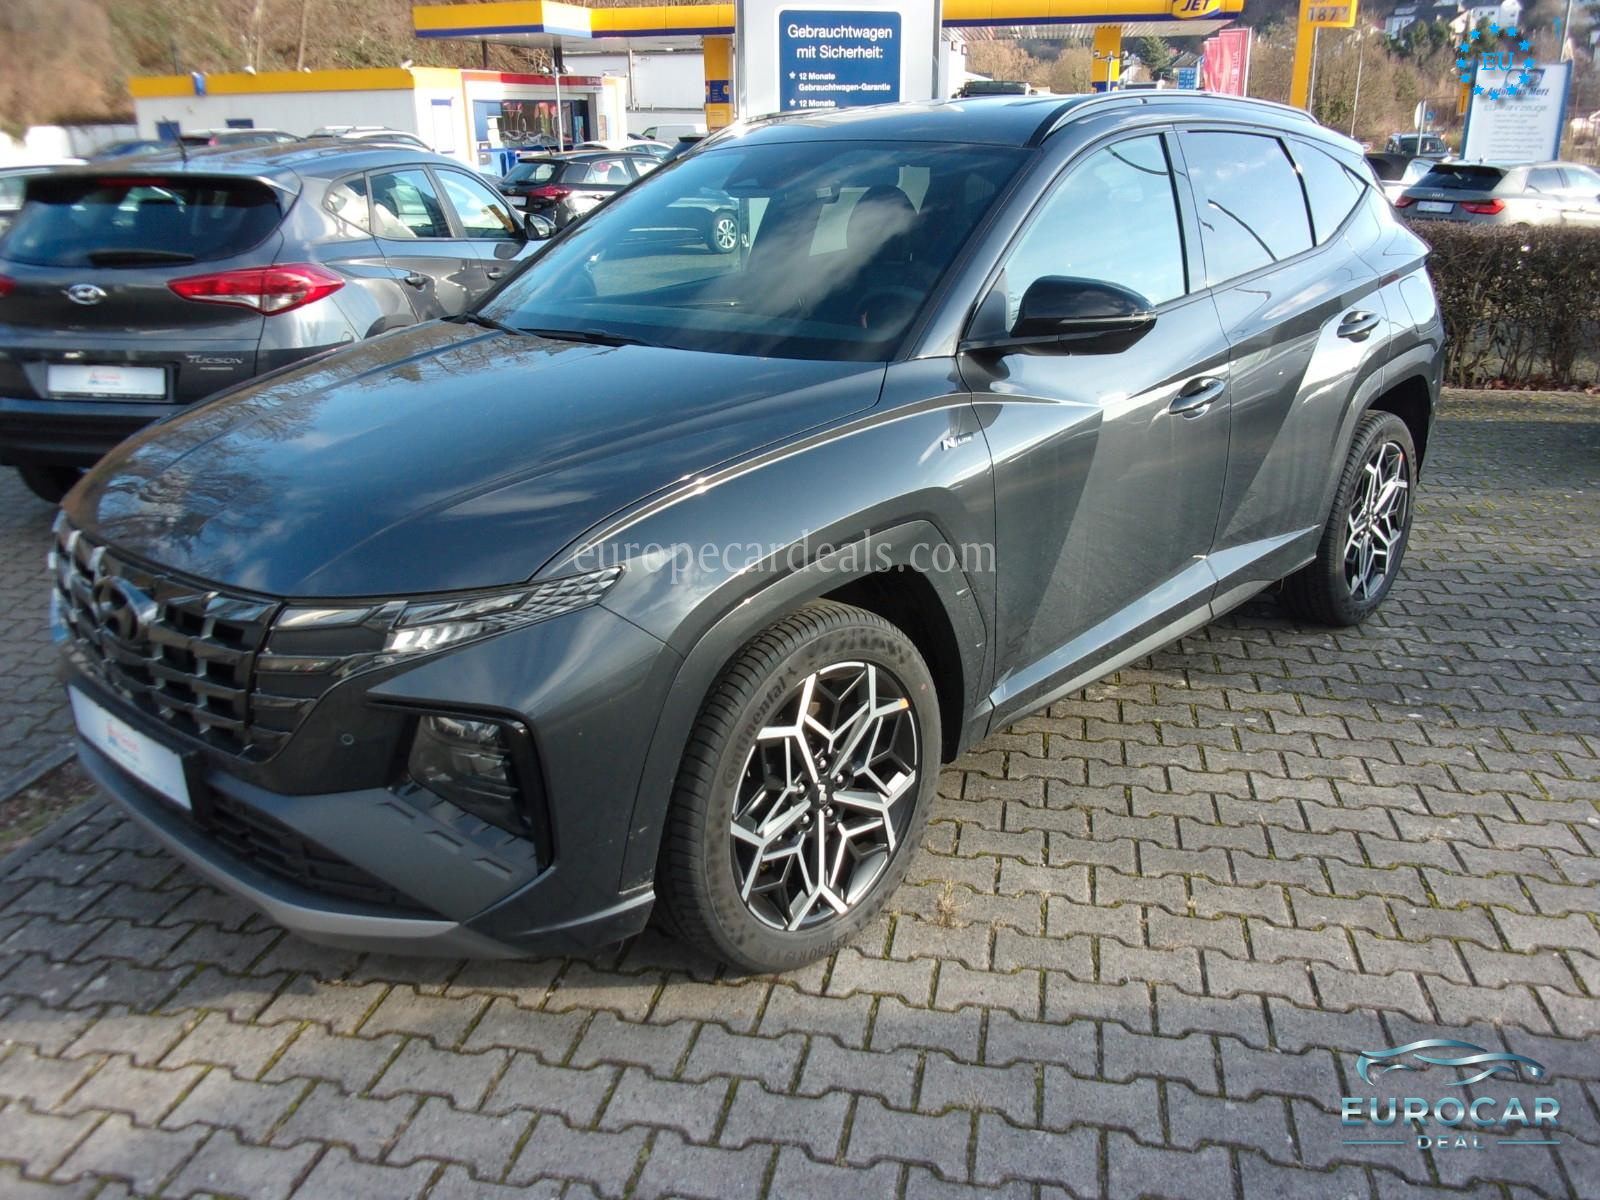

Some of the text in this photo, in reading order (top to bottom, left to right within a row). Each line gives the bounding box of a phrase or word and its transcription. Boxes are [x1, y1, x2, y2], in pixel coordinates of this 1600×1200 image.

[1181, 0, 1209, 11] JET
[787, 24, 892, 41] Gebrauchtwagen
[796, 45, 883, 59] mit Sicherheit:
[799, 72, 807, 80] 12
[798, 83, 891, 92] Gebrauchtwagen-Garantie
